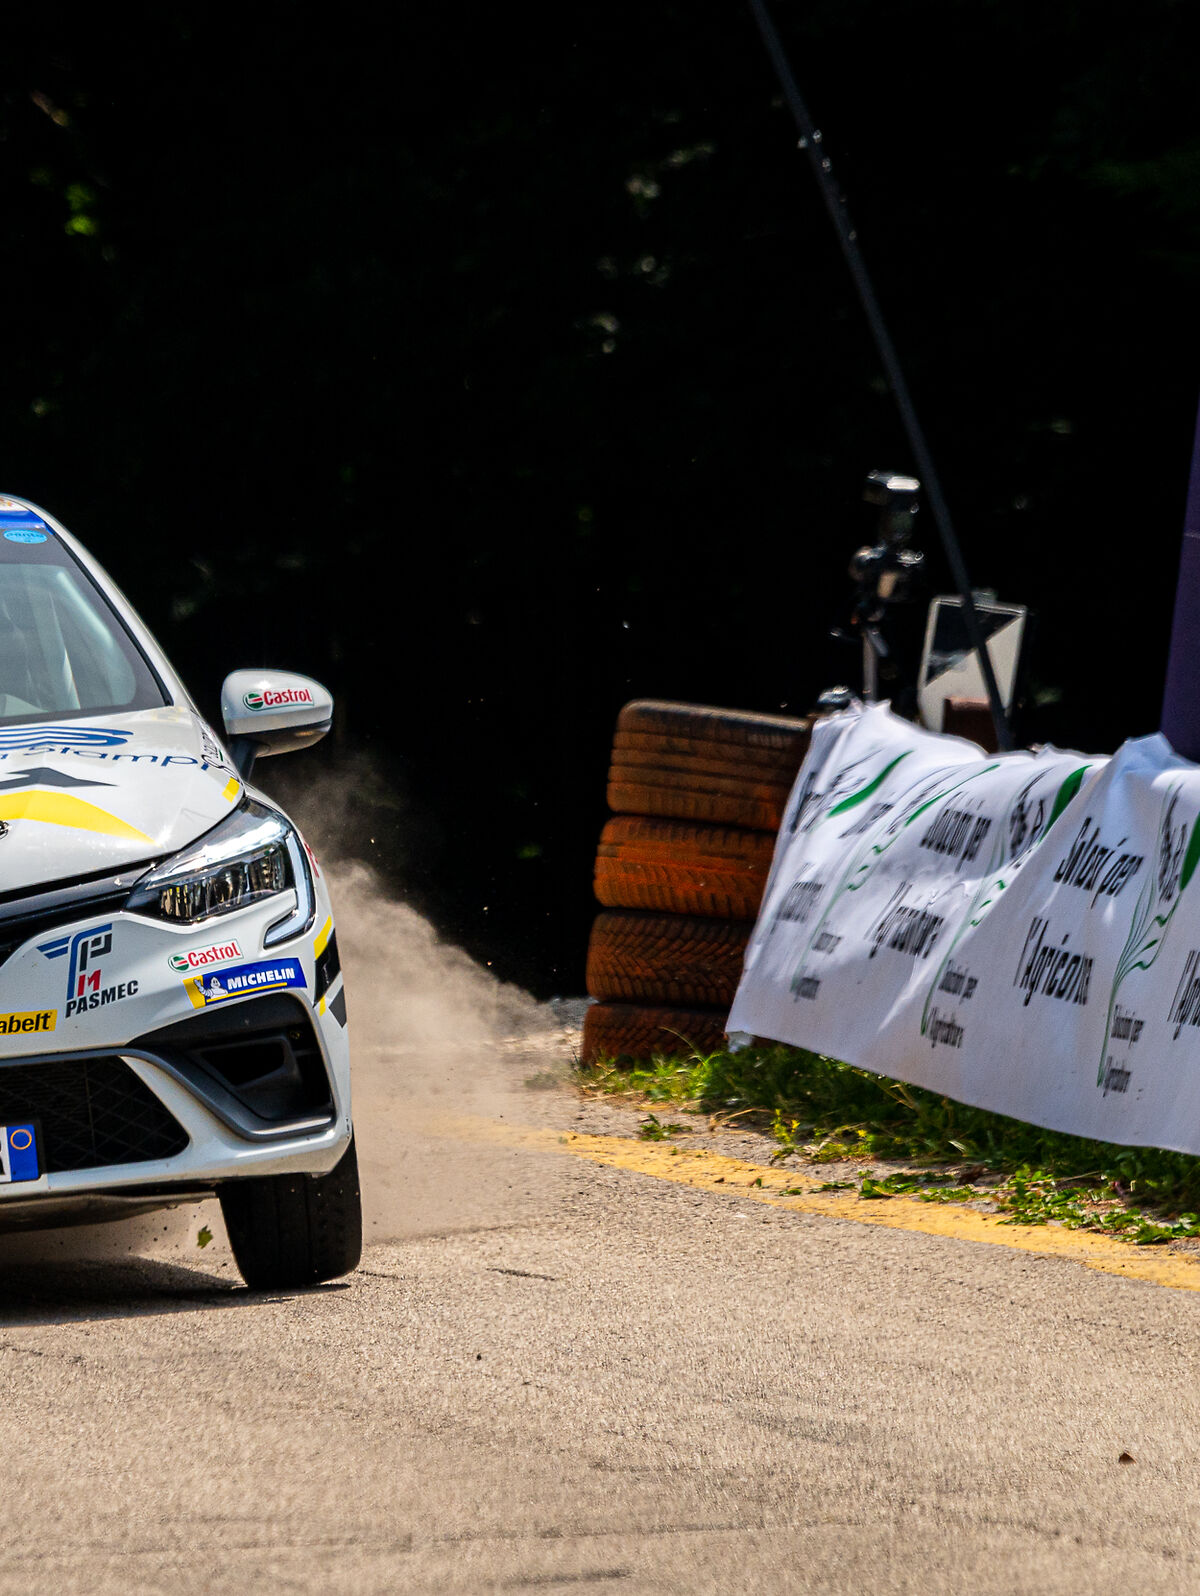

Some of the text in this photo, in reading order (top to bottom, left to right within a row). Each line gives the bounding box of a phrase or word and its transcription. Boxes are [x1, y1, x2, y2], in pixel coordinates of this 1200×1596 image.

[263, 688, 312, 706] Castrol
[188, 942, 241, 967] Castrol
[227, 967, 296, 990] MICHELIN
[65, 980, 139, 1018] PASMEC
